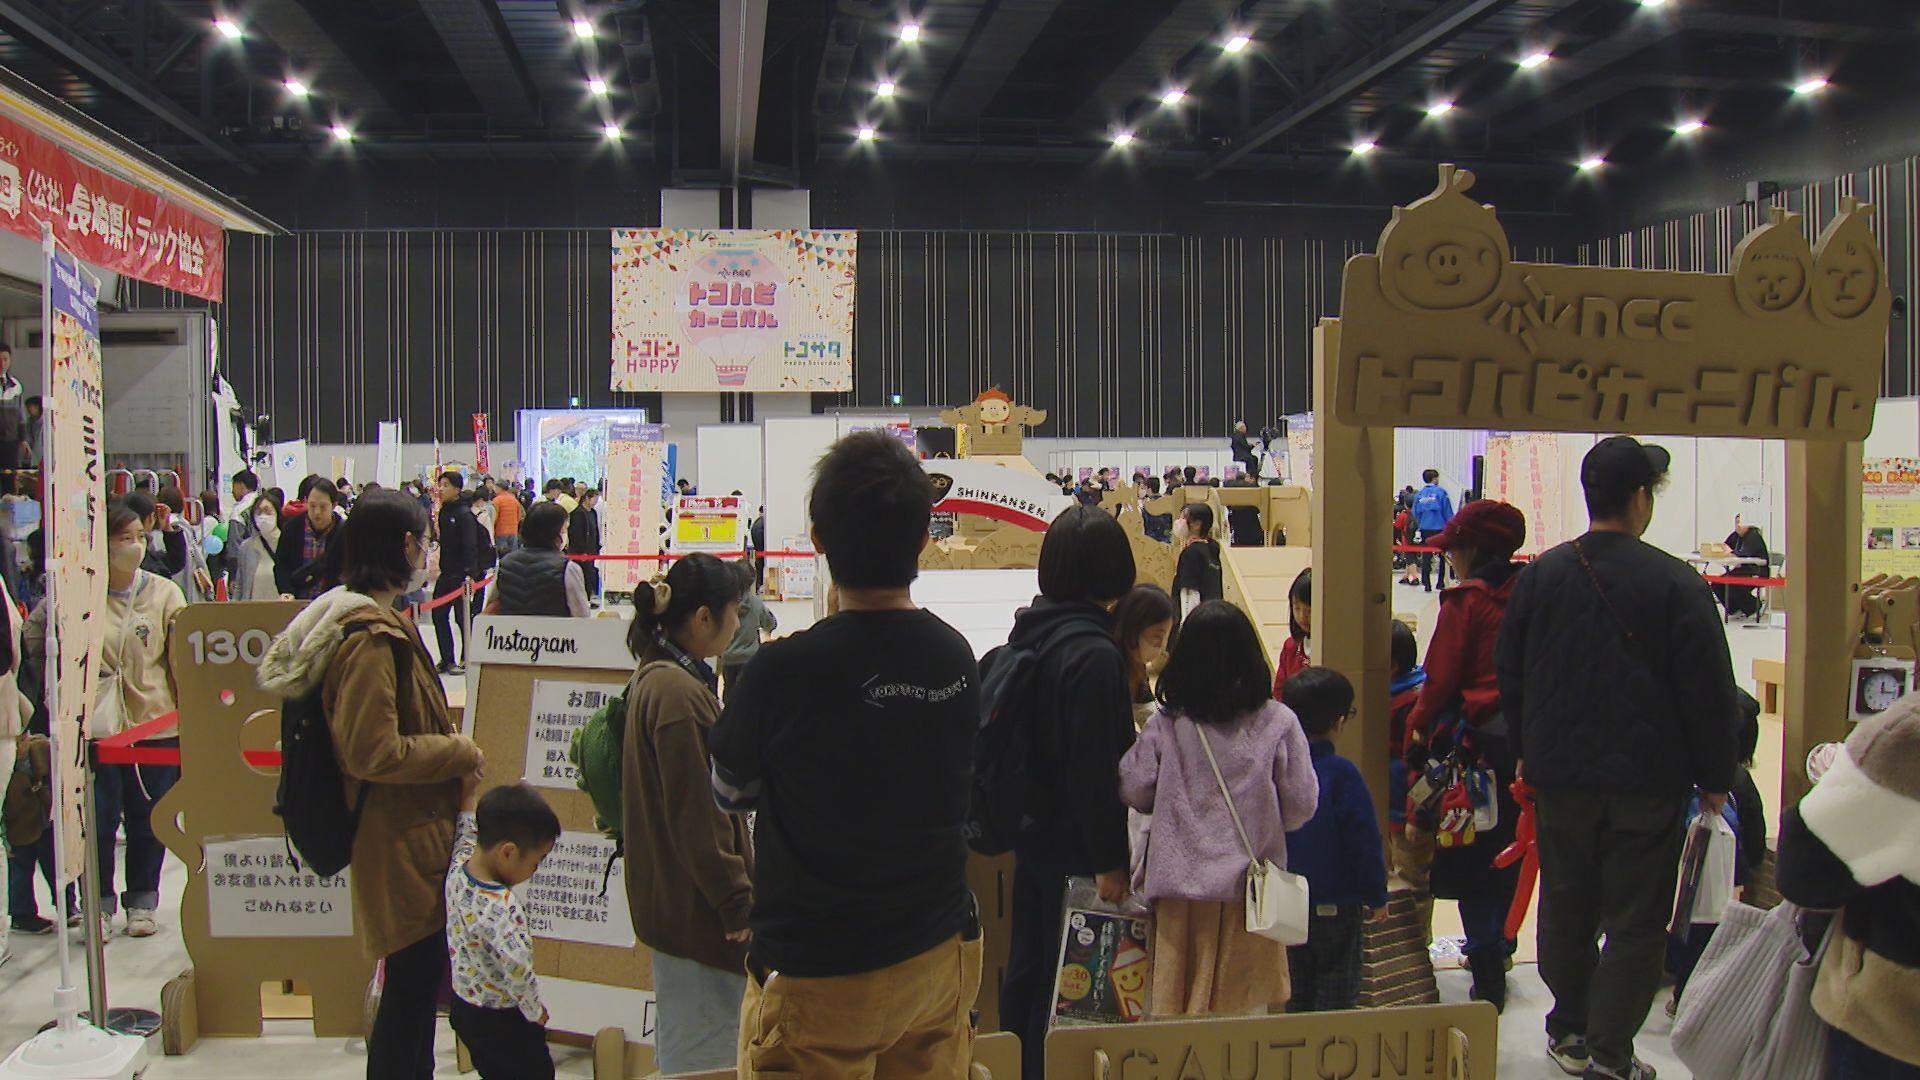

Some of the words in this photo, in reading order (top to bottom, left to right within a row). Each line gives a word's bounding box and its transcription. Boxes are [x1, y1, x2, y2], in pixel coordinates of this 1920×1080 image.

[689, 281, 778, 306] トコハピ
[688, 309, 779, 328] カーニバル
[627, 340, 680, 358] トコトン
[627, 359, 679, 374] Happy
[957, 487, 1046, 518] SHINKANSEN
[485, 625, 579, 662] Instagram
[244, 899, 333, 914] ごめんなさい
